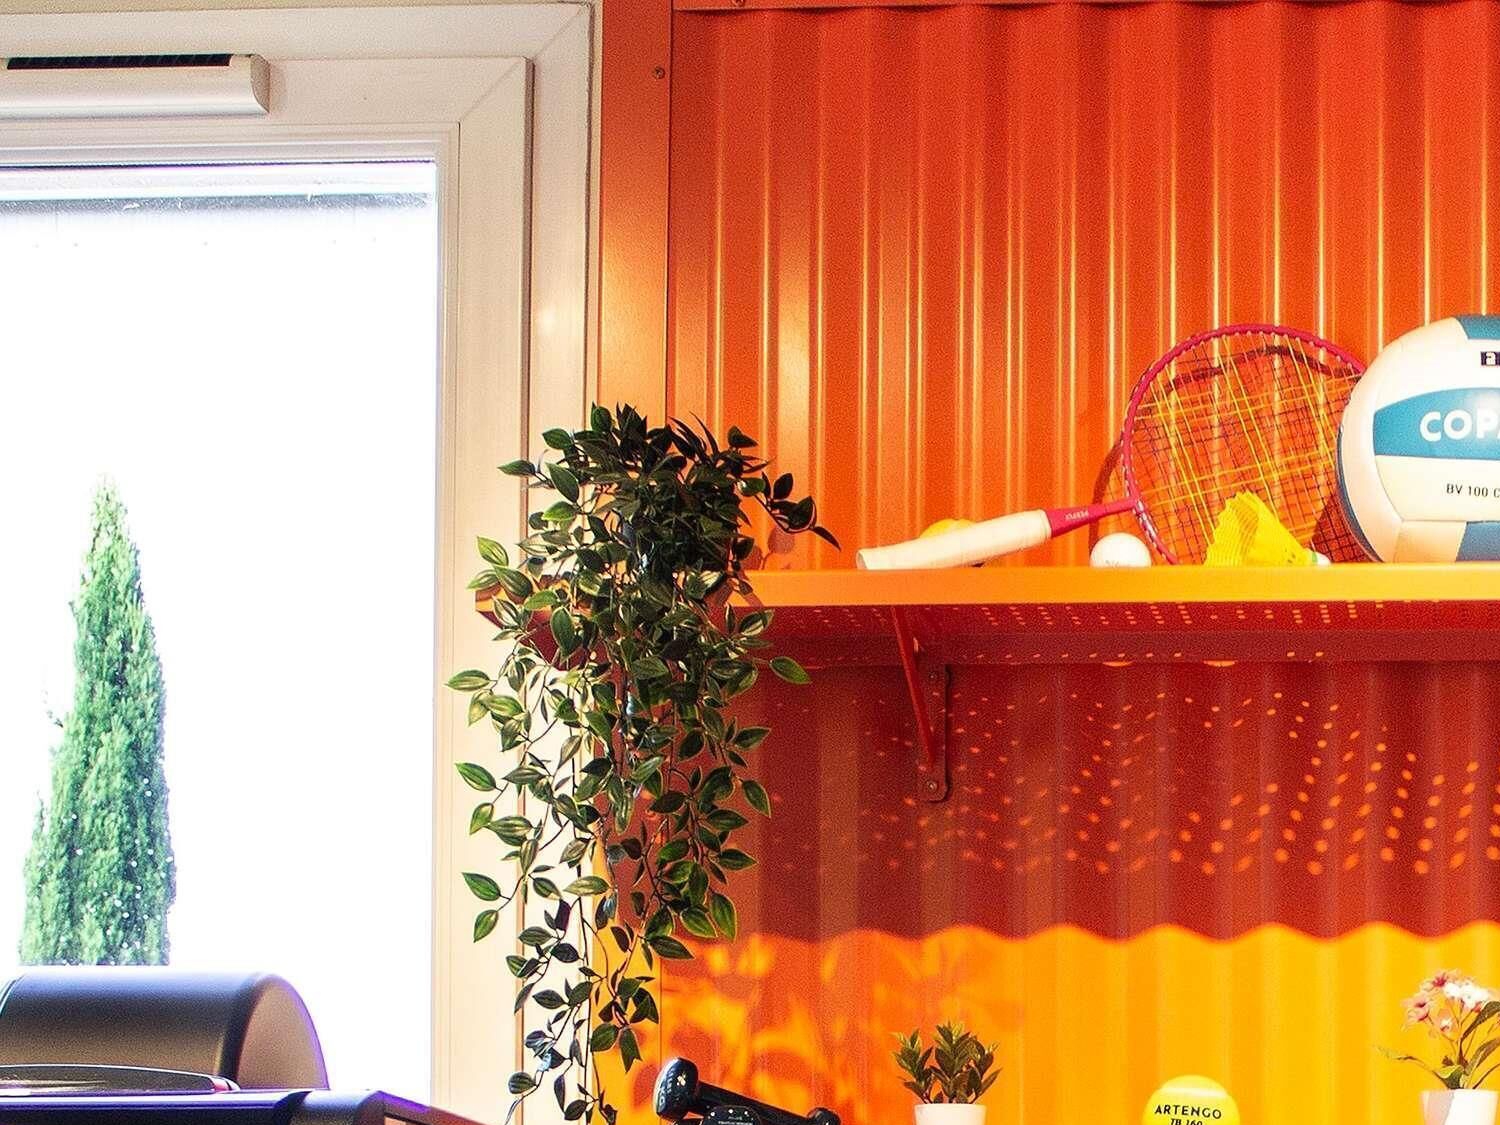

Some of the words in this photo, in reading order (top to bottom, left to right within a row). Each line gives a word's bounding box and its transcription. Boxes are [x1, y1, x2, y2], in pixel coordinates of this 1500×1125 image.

[1446, 482, 1463, 495] BV
[1468, 485, 1489, 497] 100
[1155, 1104, 1222, 1120] ARTENGO
